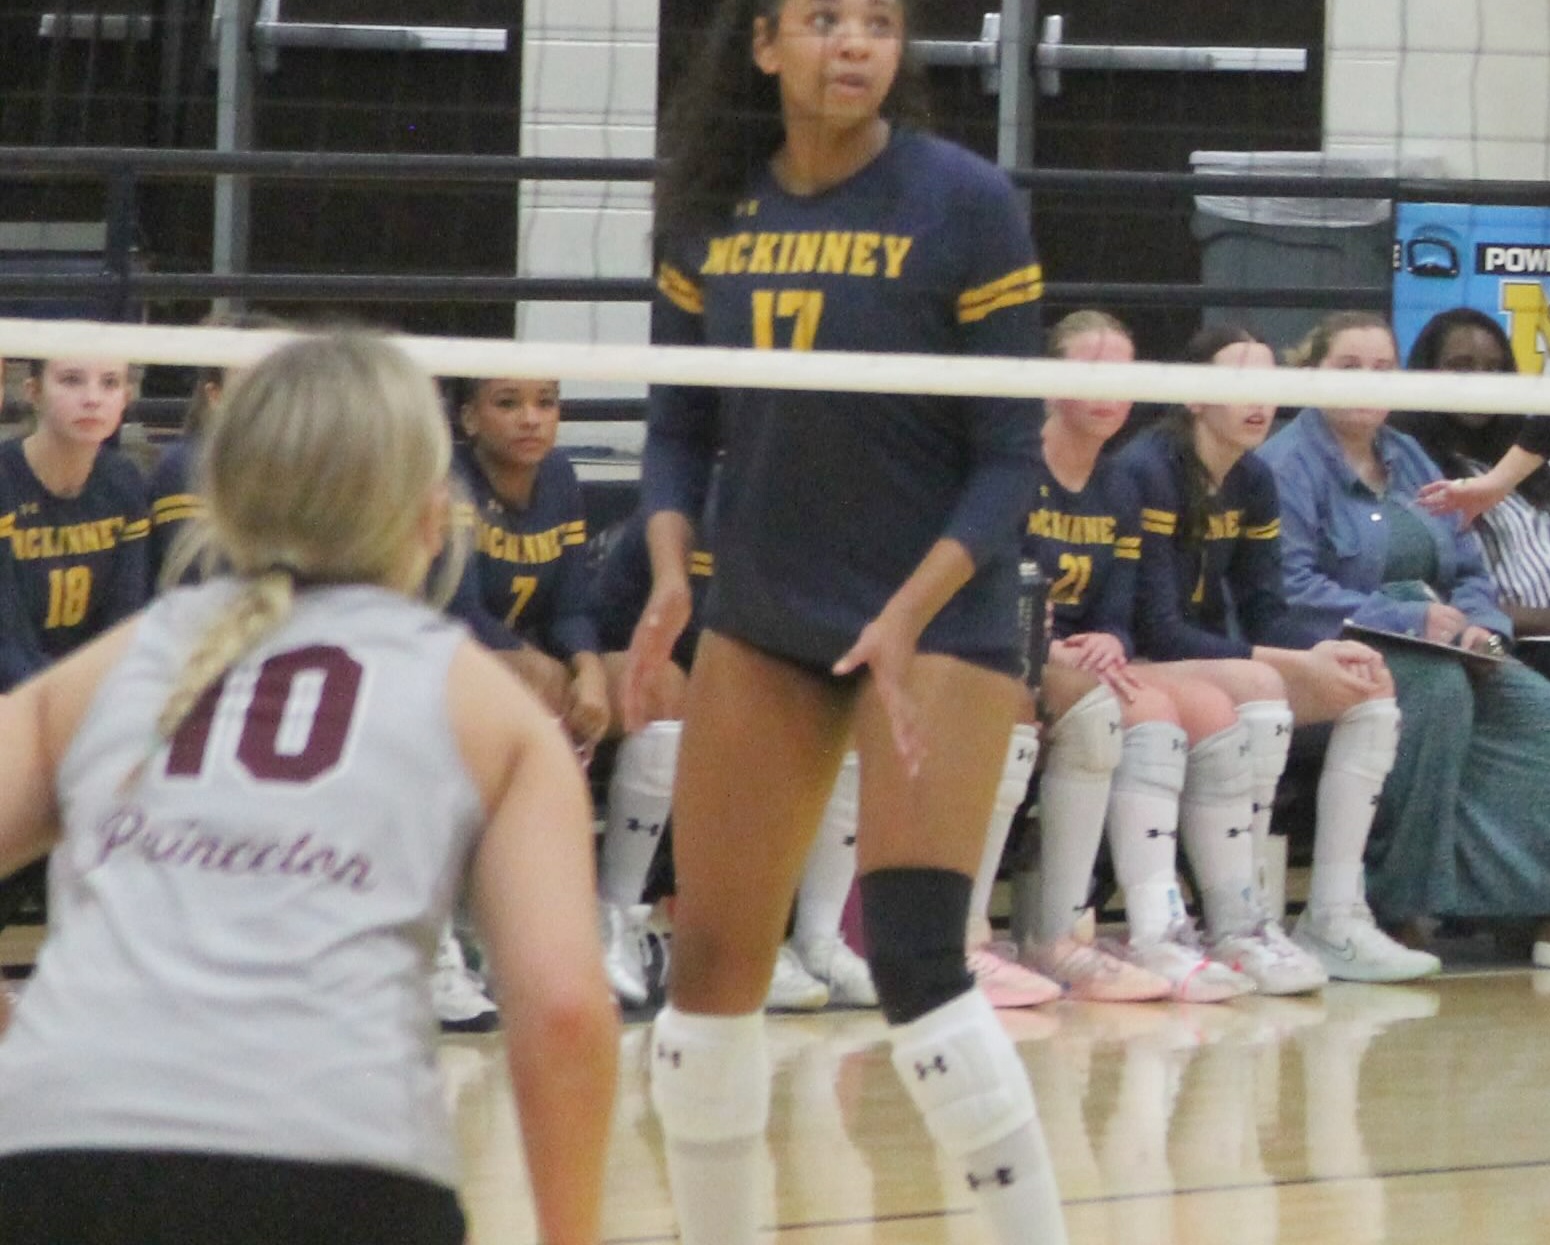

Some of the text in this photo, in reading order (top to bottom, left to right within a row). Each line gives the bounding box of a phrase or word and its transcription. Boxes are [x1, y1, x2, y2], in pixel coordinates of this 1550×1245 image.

[701, 230, 913, 280] MCKINNEY
[752, 289, 825, 352] 17
[45, 564, 93, 629] 18
[504, 574, 538, 630] 7
[1050, 552, 1093, 605] 21
[163, 643, 364, 783] 10
[95, 806, 377, 894] Princeton
